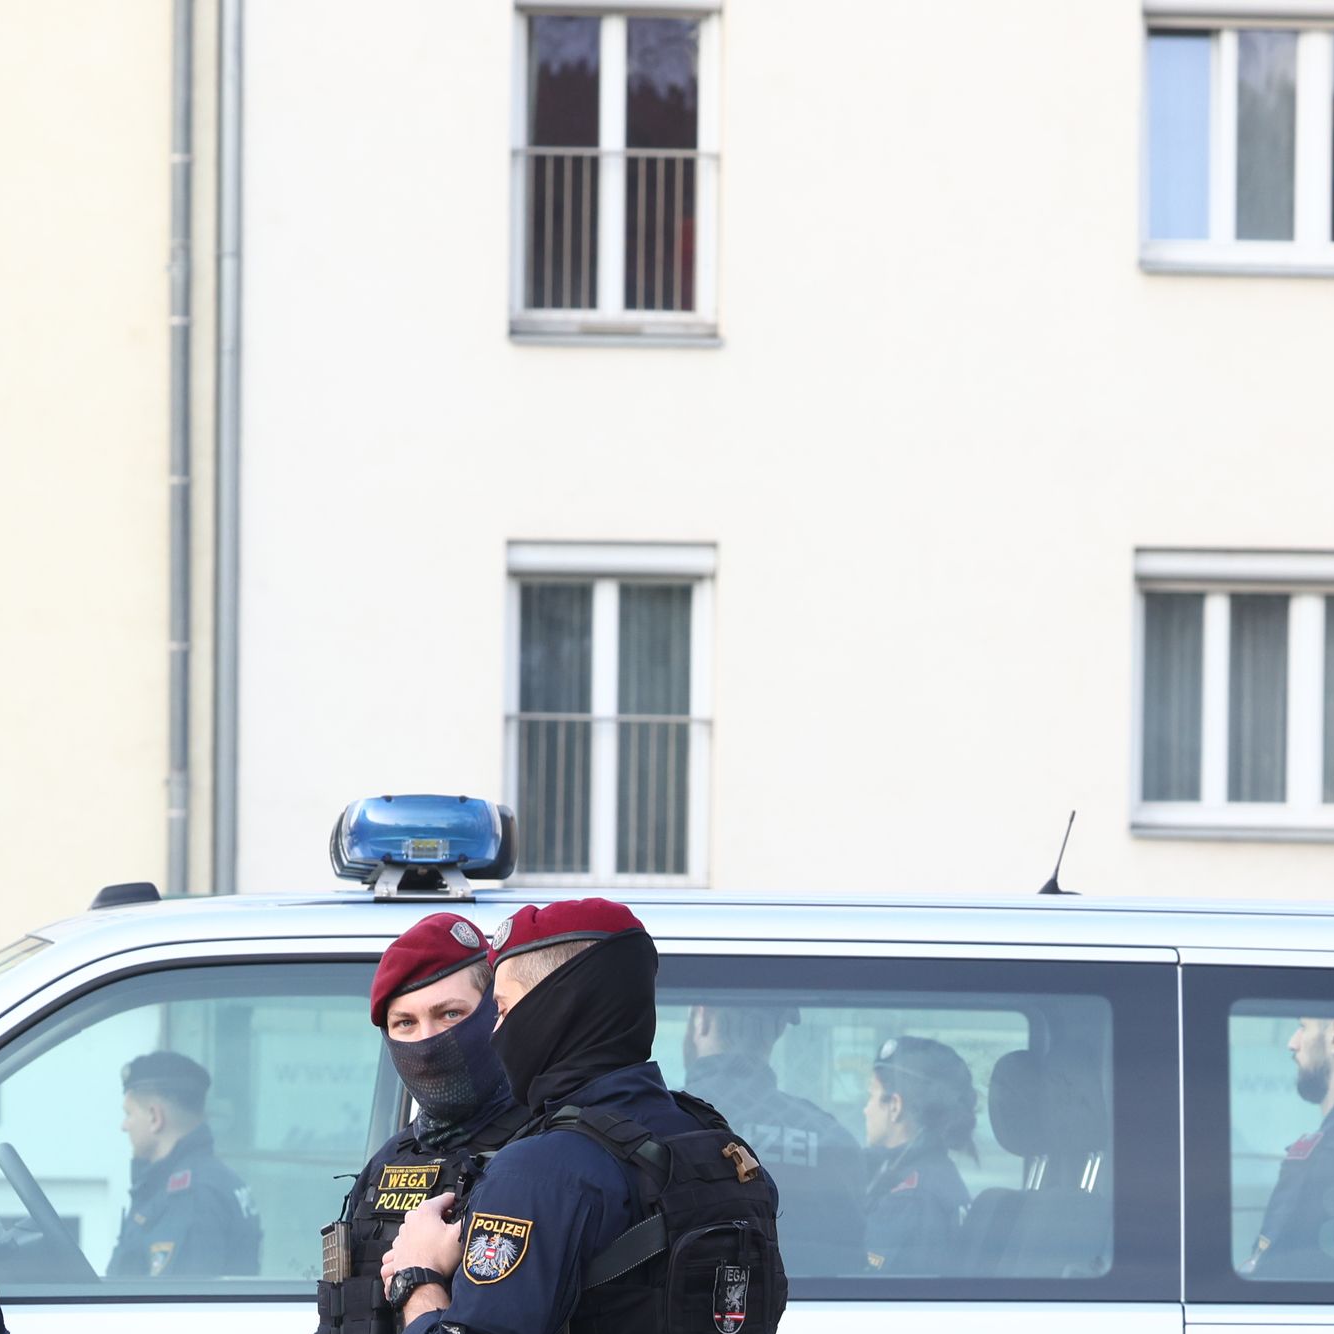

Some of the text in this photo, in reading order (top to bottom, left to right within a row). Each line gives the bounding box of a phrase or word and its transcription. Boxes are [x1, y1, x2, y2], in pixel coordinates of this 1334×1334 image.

[388, 1173, 427, 1188] WEGA
[474, 1218, 527, 1239] POLIZEI
[724, 1269, 747, 1282] EGA
